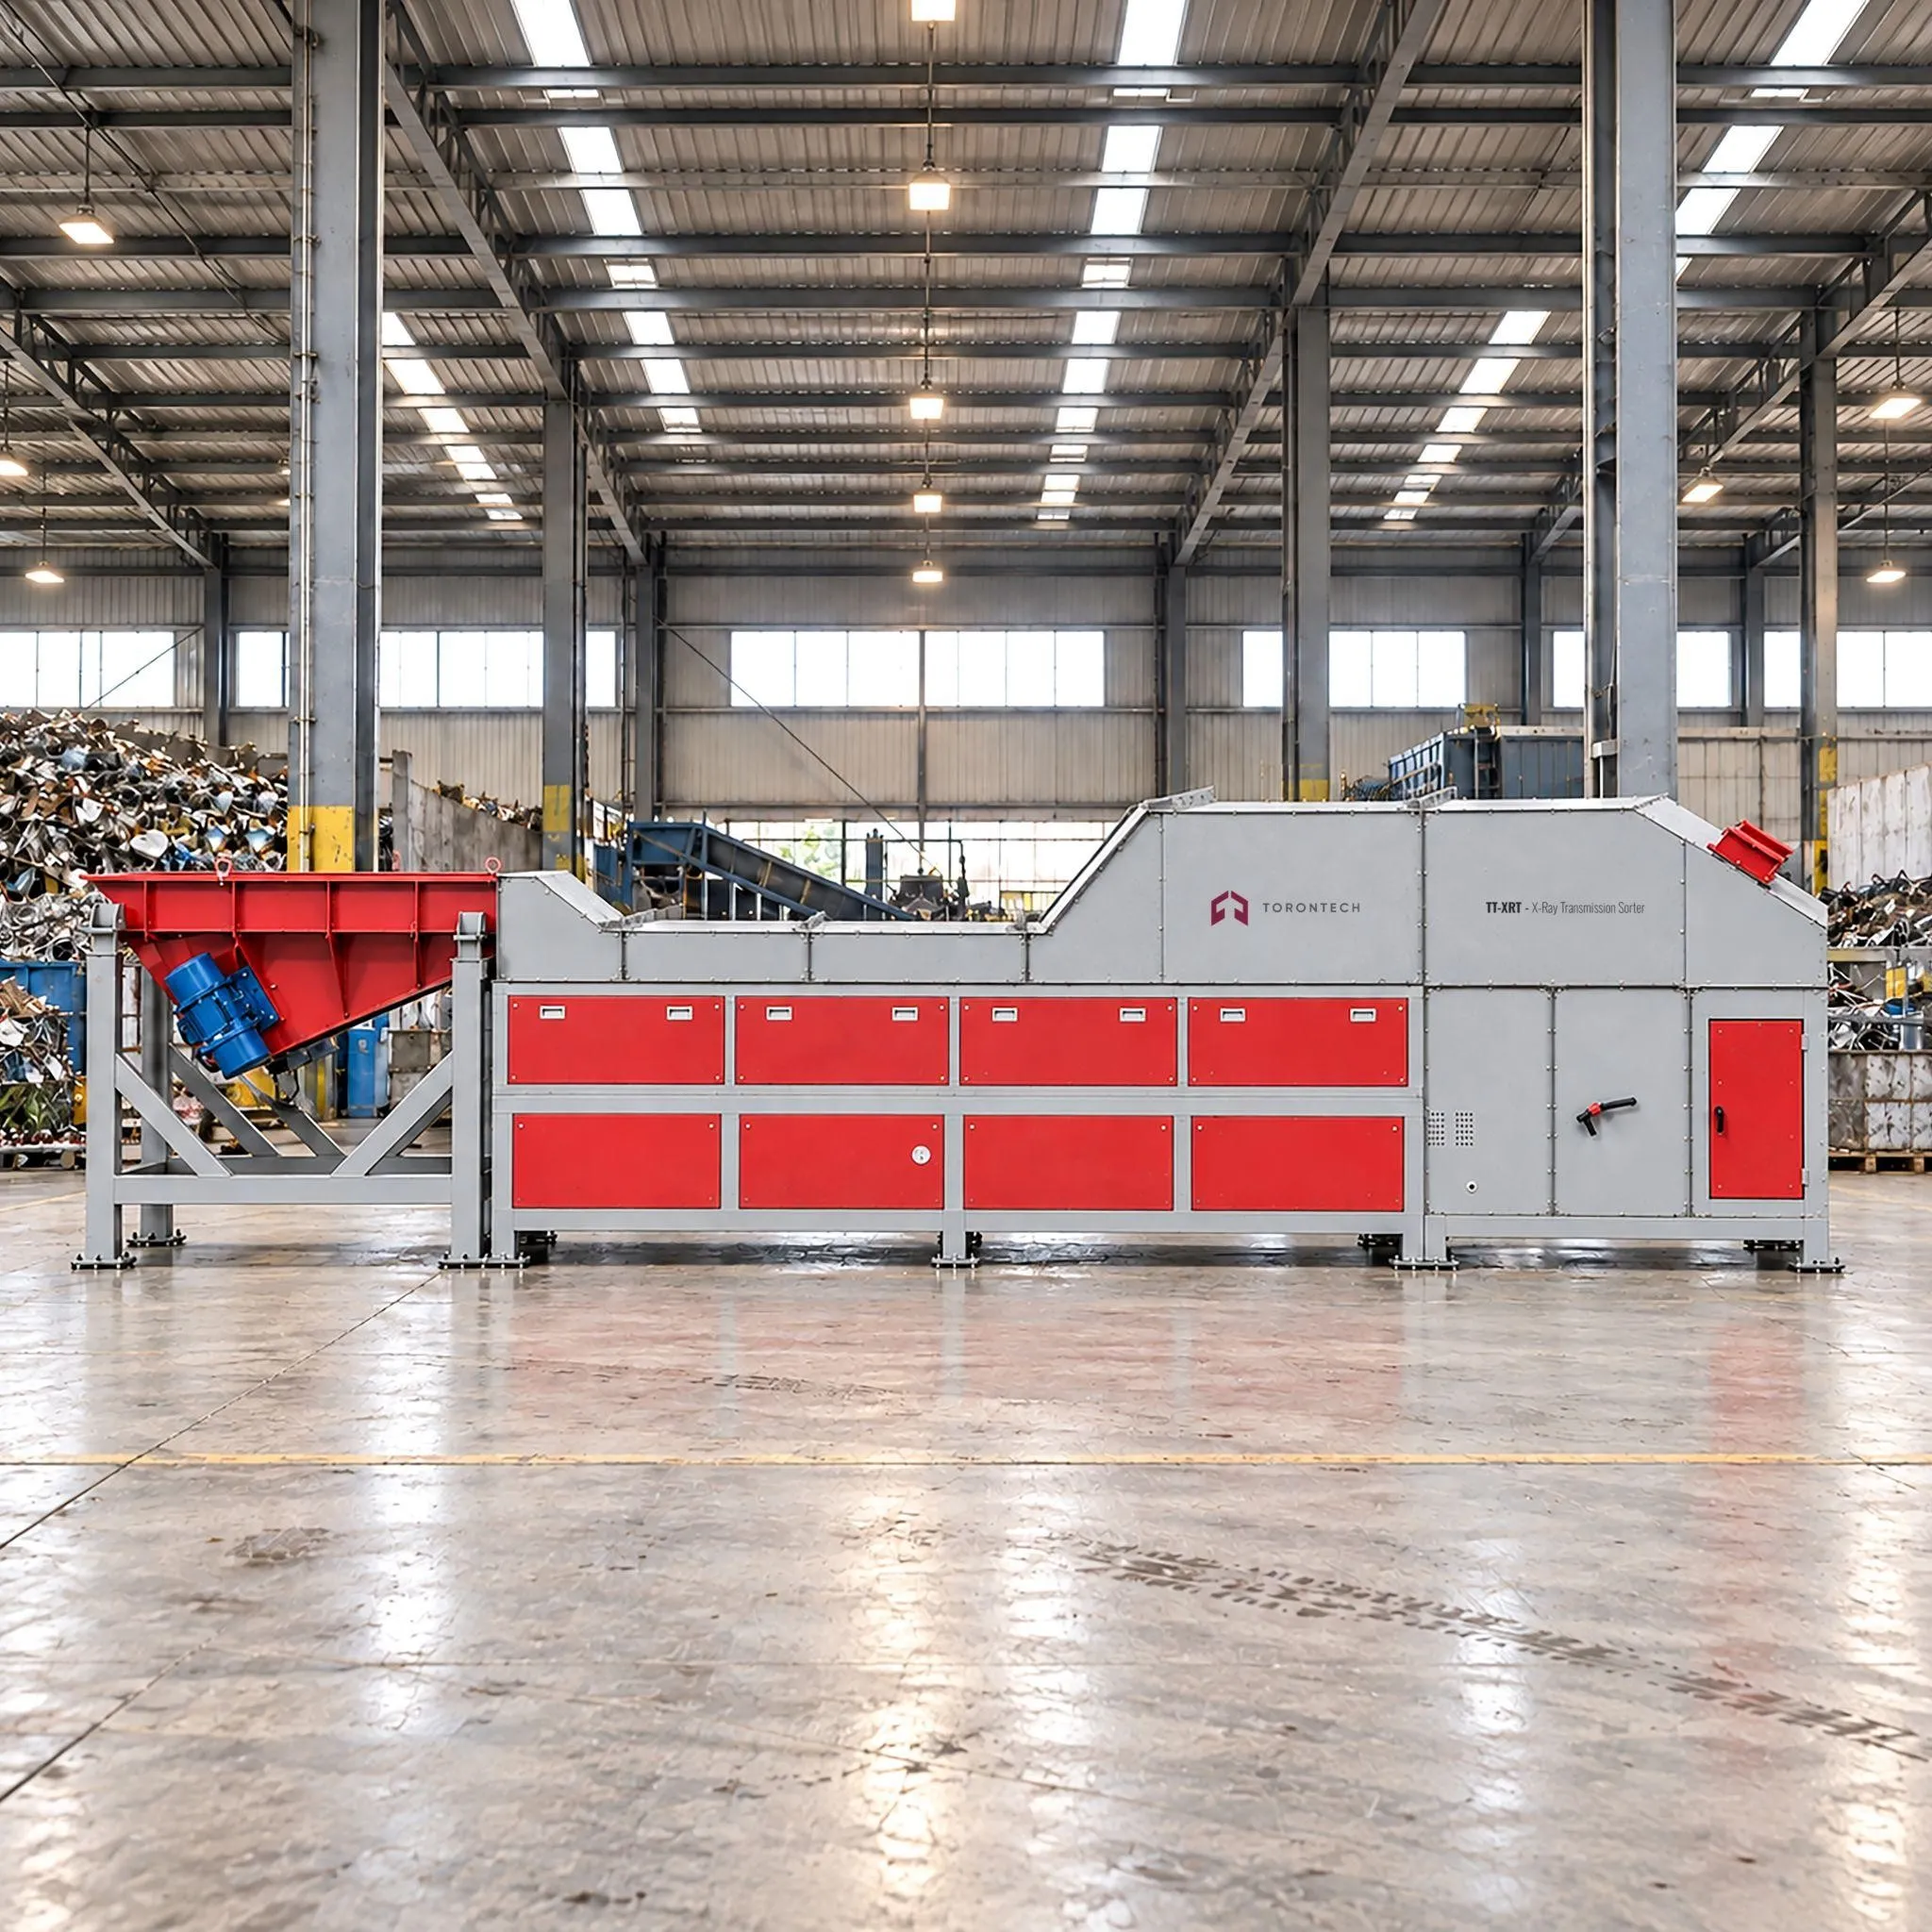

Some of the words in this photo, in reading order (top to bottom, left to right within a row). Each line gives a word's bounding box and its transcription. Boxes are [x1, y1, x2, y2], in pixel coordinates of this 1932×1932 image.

[1262, 903, 1360, 913] TORONTECH
[1486, 902, 1523, 913] TT-XRT
[1532, 902, 1557, 915] X-Ray
[1560, 902, 1616, 913] Transmission
[1618, 902, 1645, 913] Sorter
